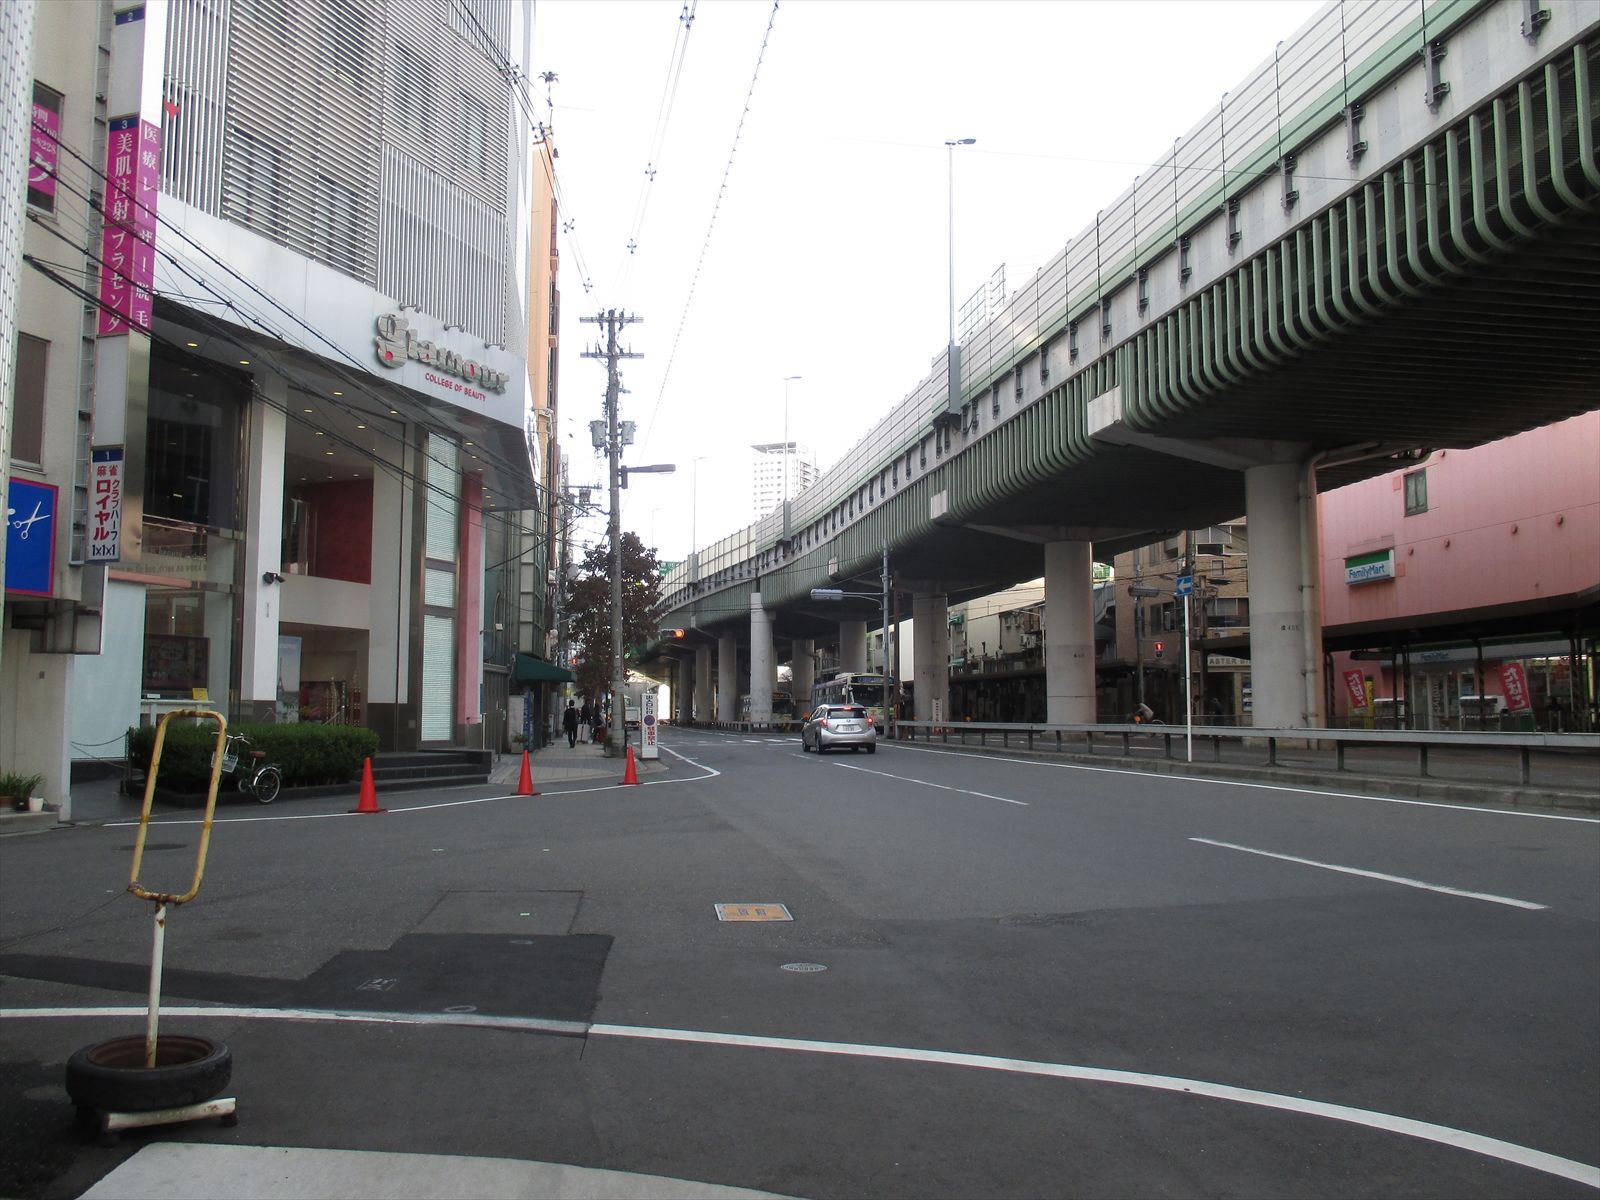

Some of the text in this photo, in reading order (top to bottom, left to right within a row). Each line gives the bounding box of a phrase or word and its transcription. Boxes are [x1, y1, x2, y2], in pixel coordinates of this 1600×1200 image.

[127, 12, 134, 22] 2
[121, 119, 129, 129] 3
[136, 124, 158, 328] 医療レーザー脱毛
[425, 372, 487, 402] COLLEGE OF BEAUTY
[106, 451, 110, 461] 1
[96, 463, 119, 477] 麻雀
[93, 479, 111, 541] ロイヤル
[1348, 563, 1386, 579] FamilyMart
